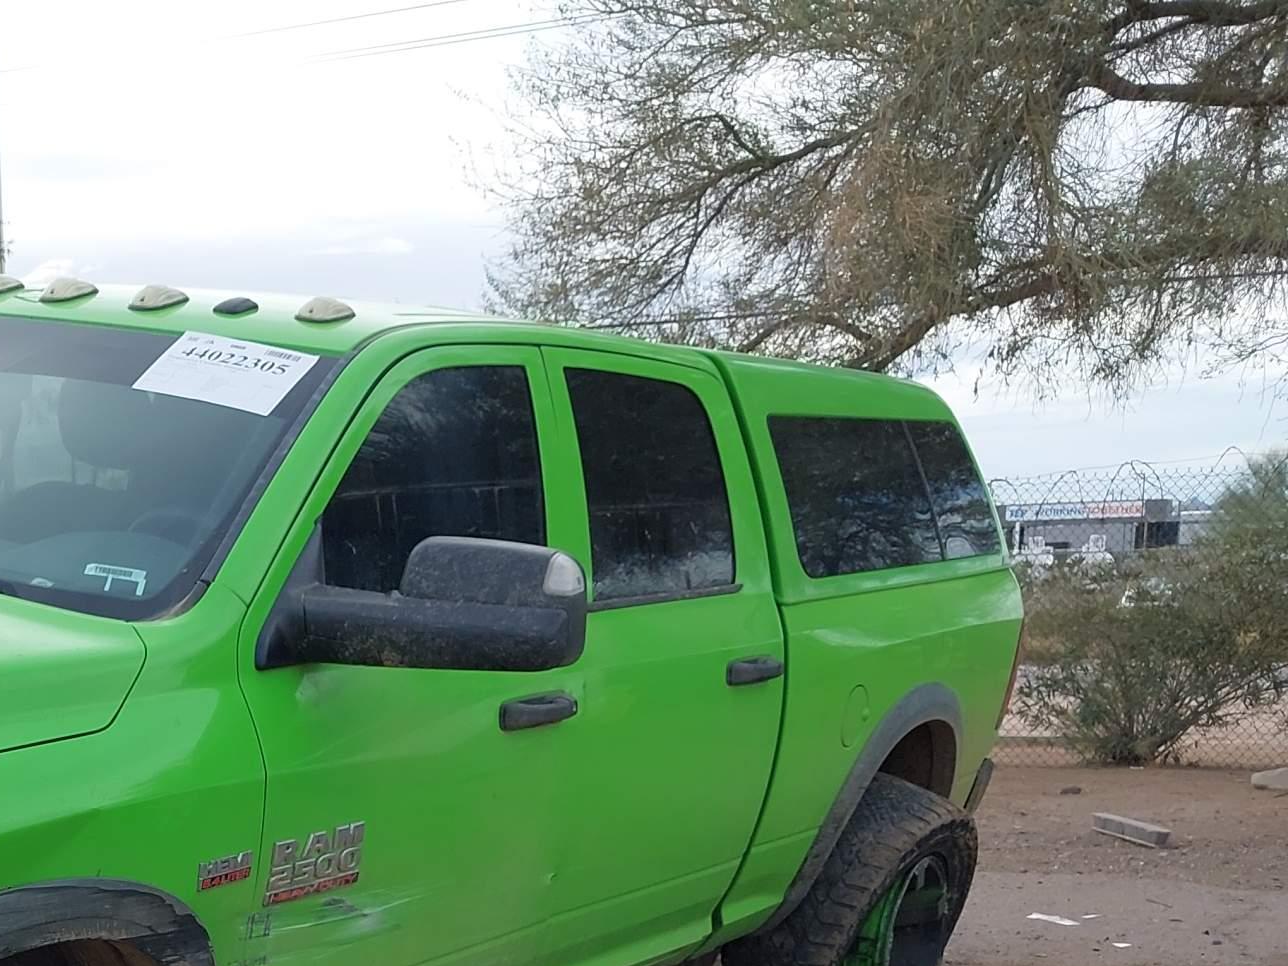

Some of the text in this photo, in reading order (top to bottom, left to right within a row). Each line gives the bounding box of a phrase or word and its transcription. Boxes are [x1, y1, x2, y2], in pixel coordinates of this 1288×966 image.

[182, 346, 292, 376] 44022305
[272, 820, 366, 867] RAM
[267, 847, 361, 890] 2500
[269, 872, 357, 904] HEAVY DUTY
